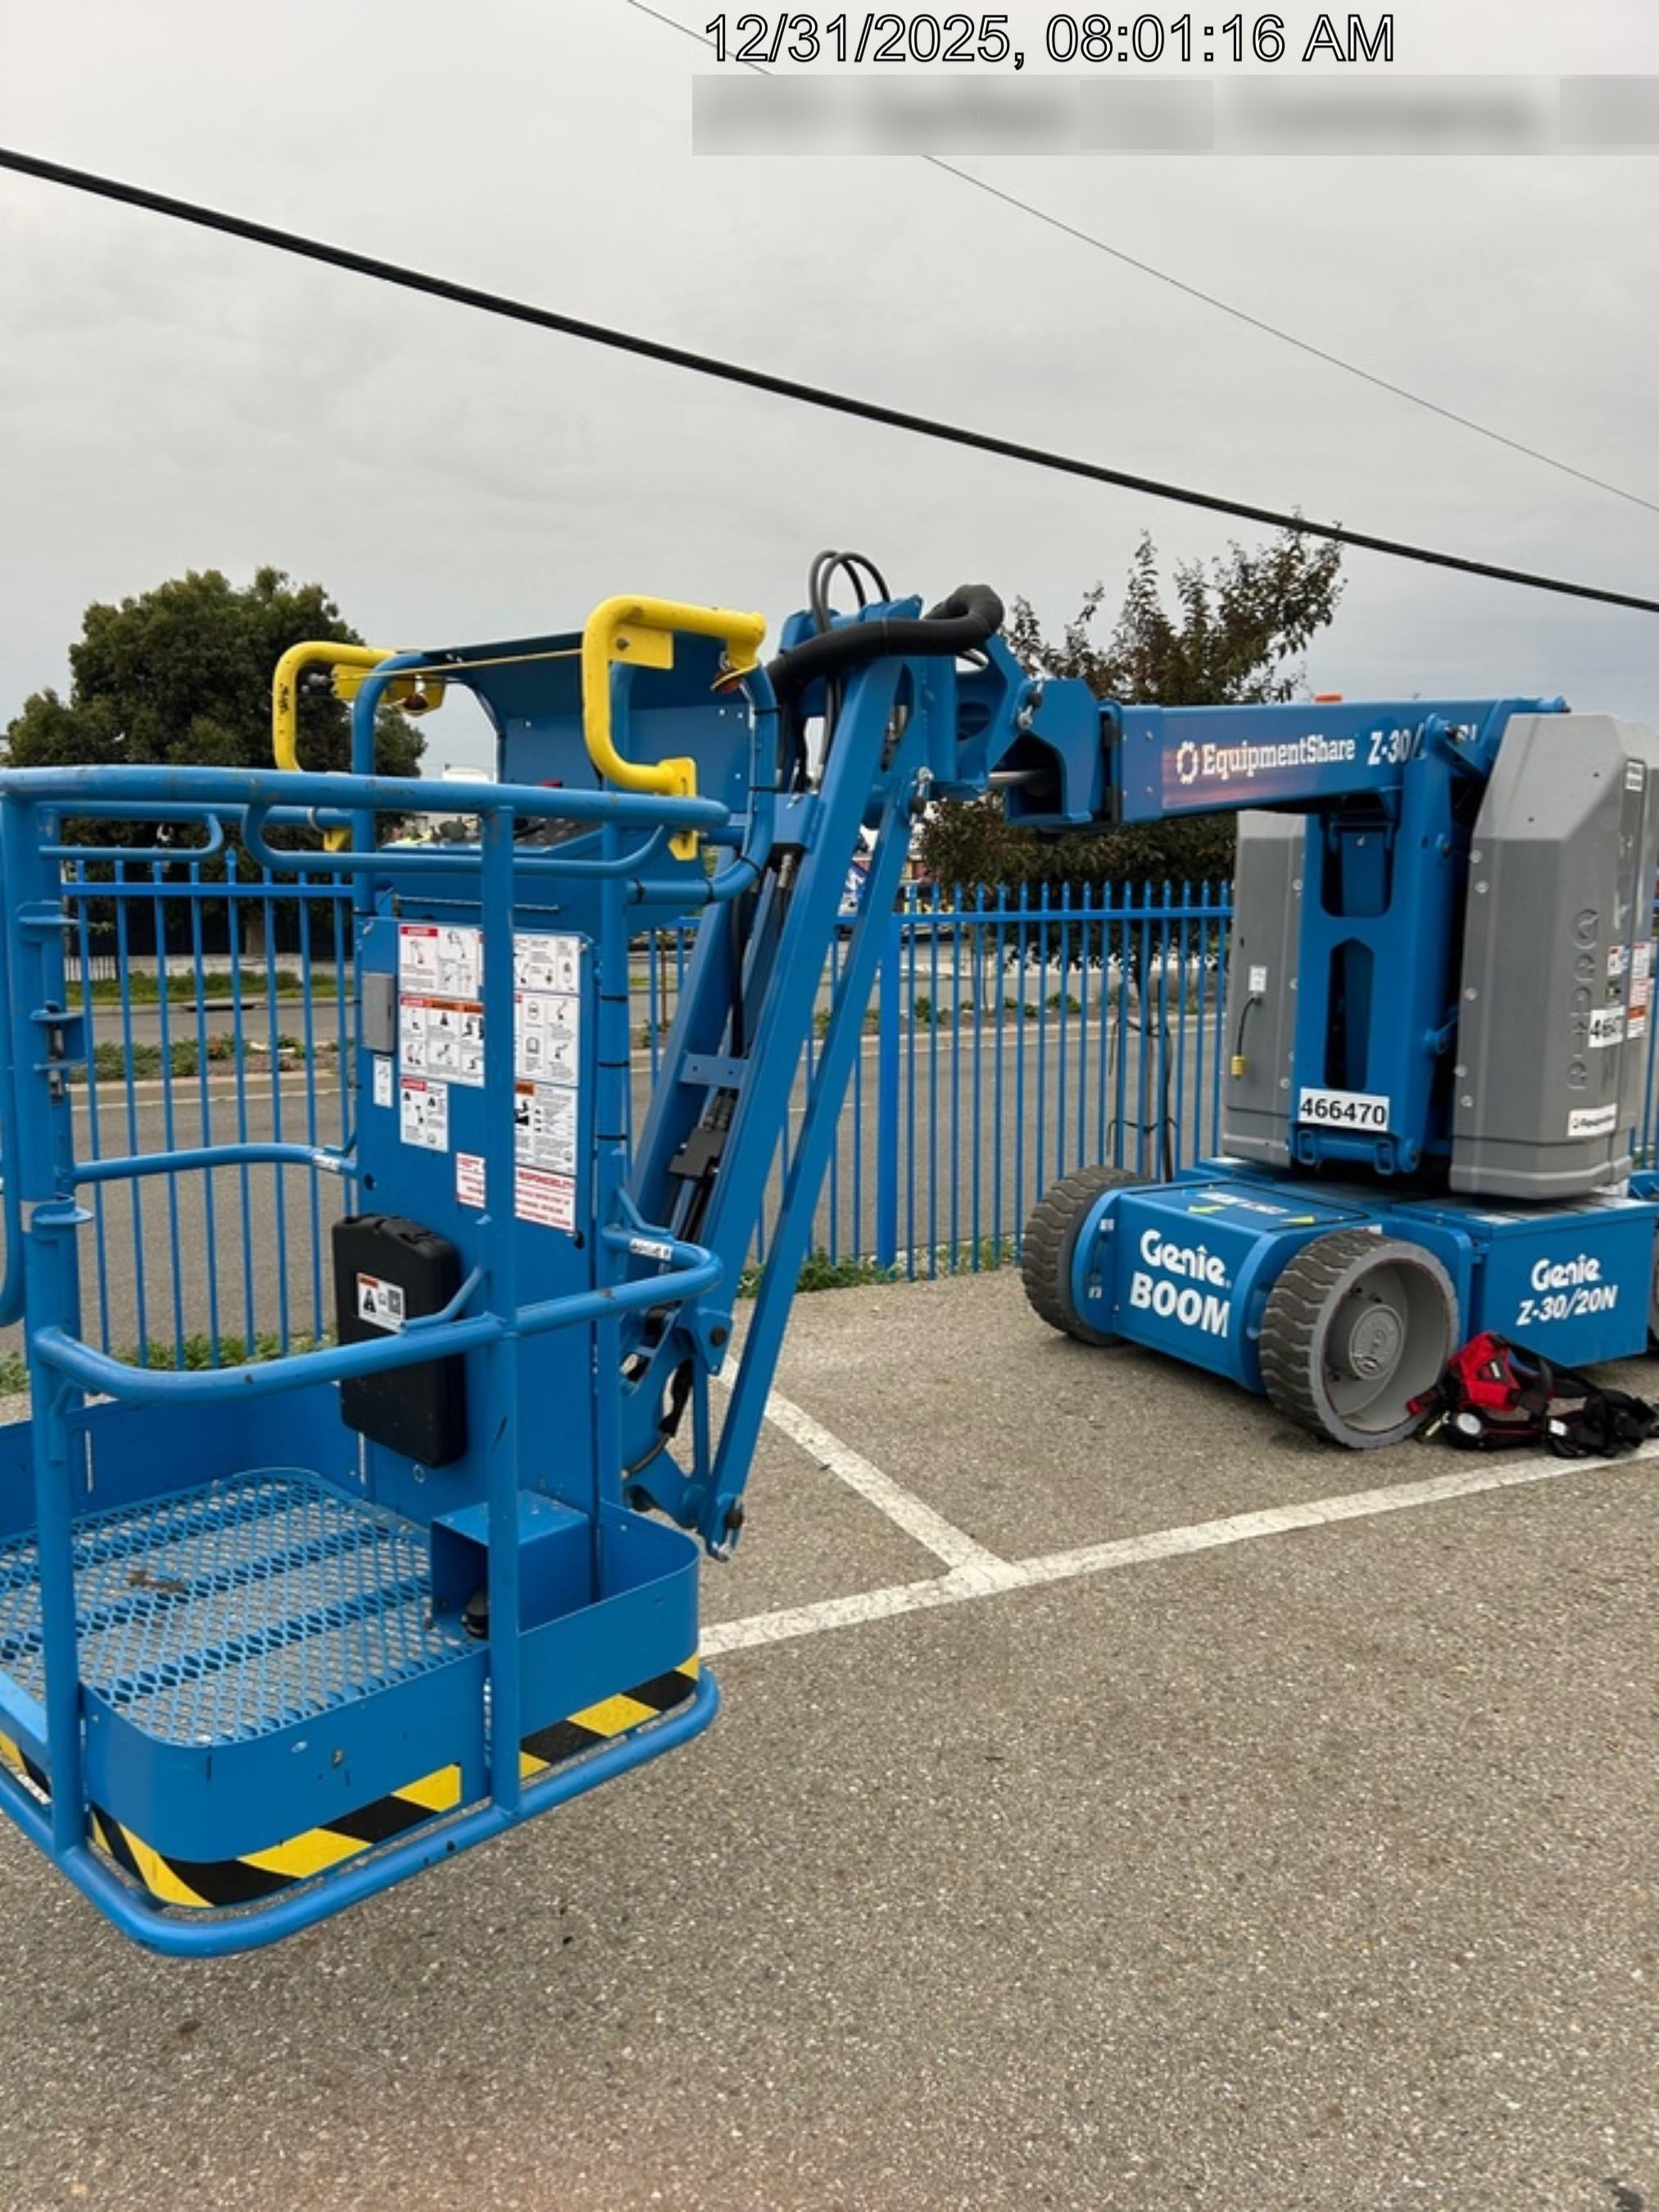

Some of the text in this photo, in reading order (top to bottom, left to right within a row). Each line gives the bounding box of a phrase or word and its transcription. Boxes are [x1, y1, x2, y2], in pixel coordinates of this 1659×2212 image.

[1201, 734, 1356, 781] EquipmentShare
[1367, 722, 1426, 765] Z-30/
[1300, 1097, 1386, 1126] 466470
[1140, 1228, 1226, 1288] Genie
[1530, 1252, 1603, 1292] Genie
[1130, 1270, 1231, 1339] BOOM
[1515, 1284, 1619, 1326] Z-30/20N
